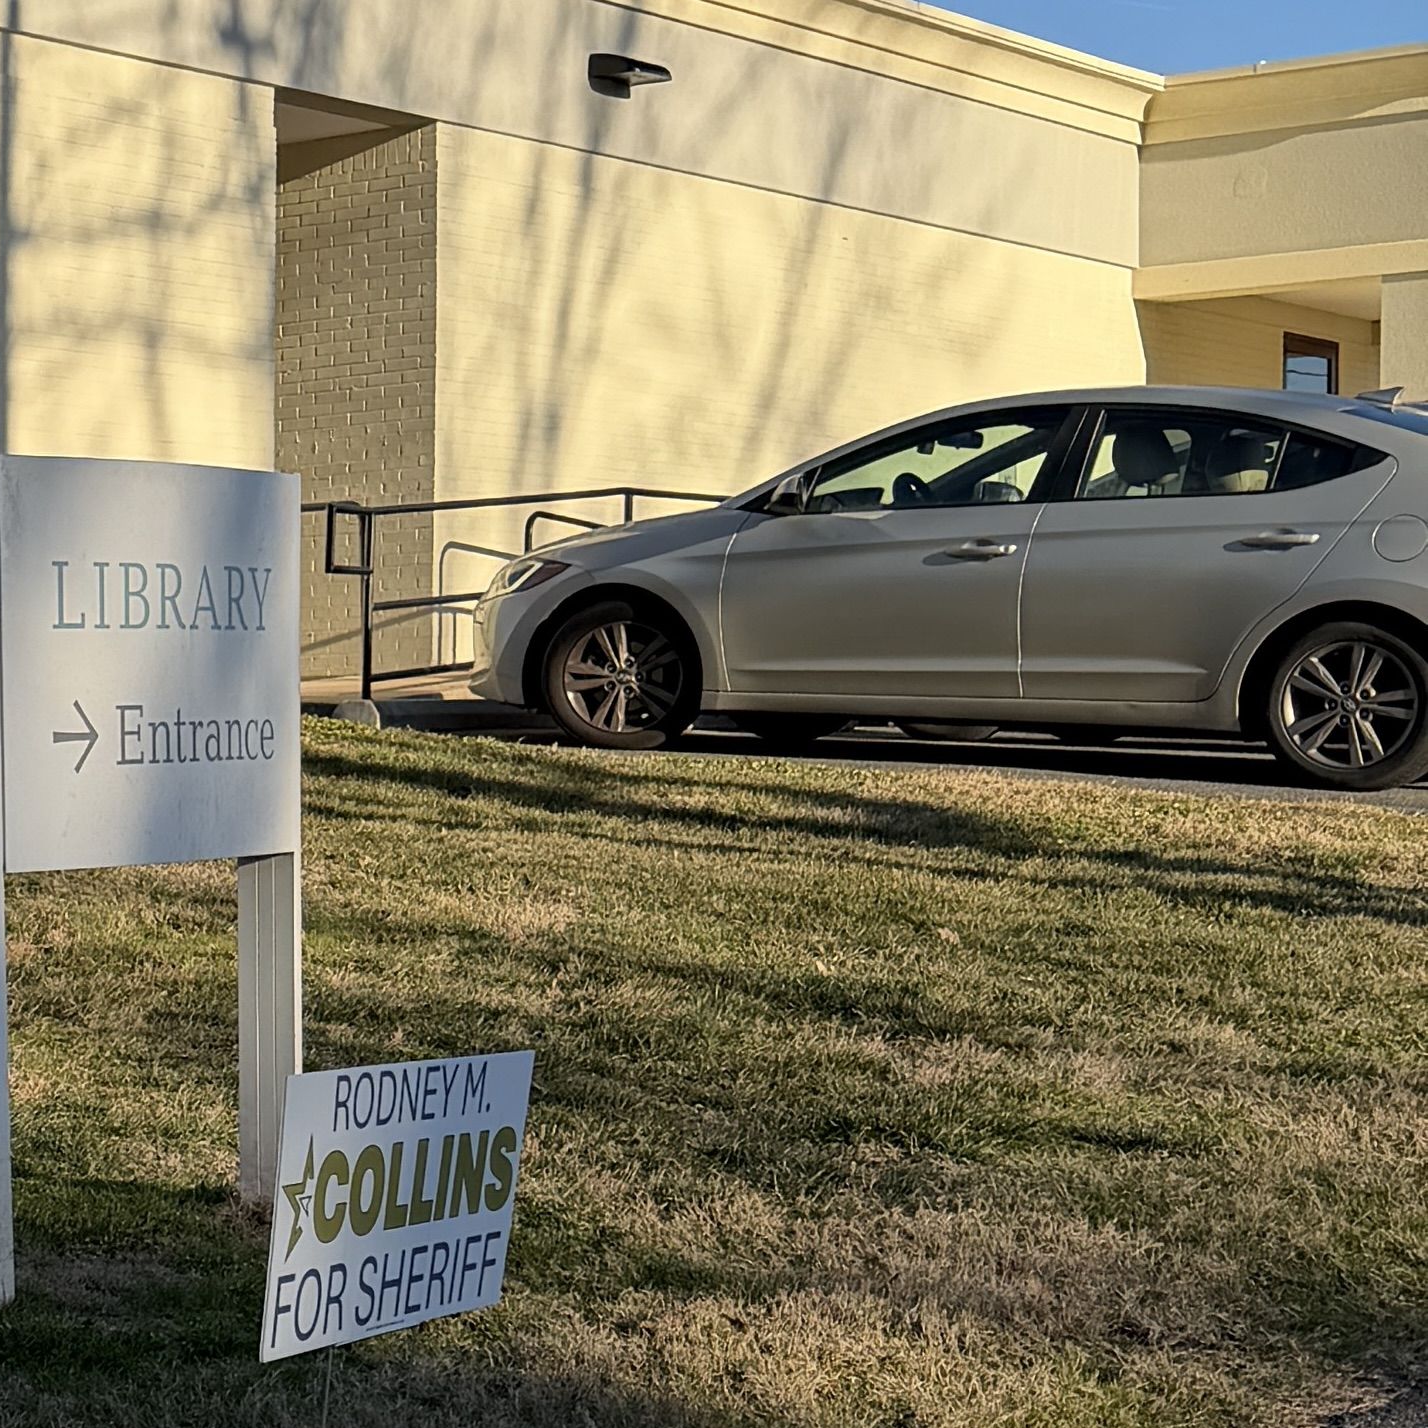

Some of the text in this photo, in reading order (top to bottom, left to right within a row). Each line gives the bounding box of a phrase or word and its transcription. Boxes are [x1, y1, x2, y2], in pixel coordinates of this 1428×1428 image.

[51, 560, 272, 632] LIBRARY
[115, 704, 275, 766] Entrance
[333, 1060, 491, 1132] RODNEY M.
[312, 1125, 517, 1244] COLLINS
[270, 1230, 502, 1349] FOR SHERIFF
